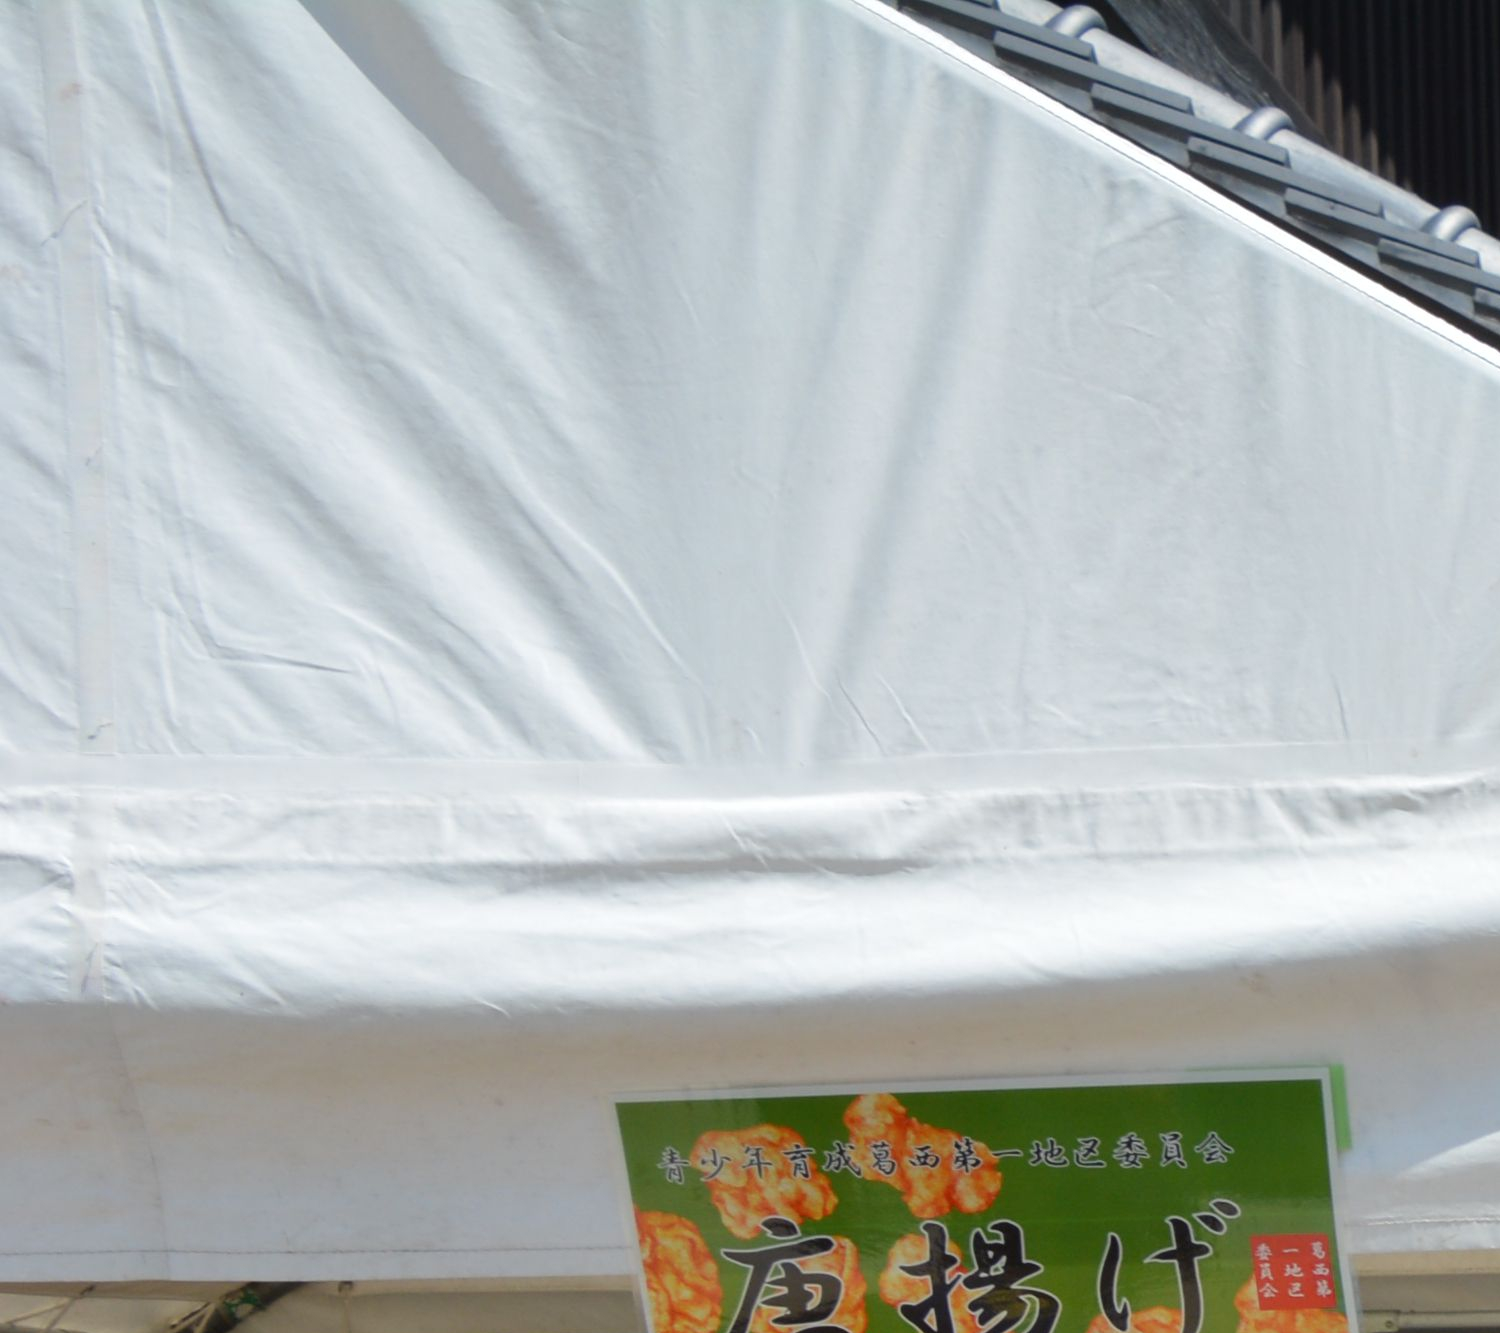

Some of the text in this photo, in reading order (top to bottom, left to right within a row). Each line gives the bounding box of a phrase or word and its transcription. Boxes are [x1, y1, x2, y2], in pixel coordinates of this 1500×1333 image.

[657, 1130, 1236, 1184] 青少年育成葛西第一地区委員会
